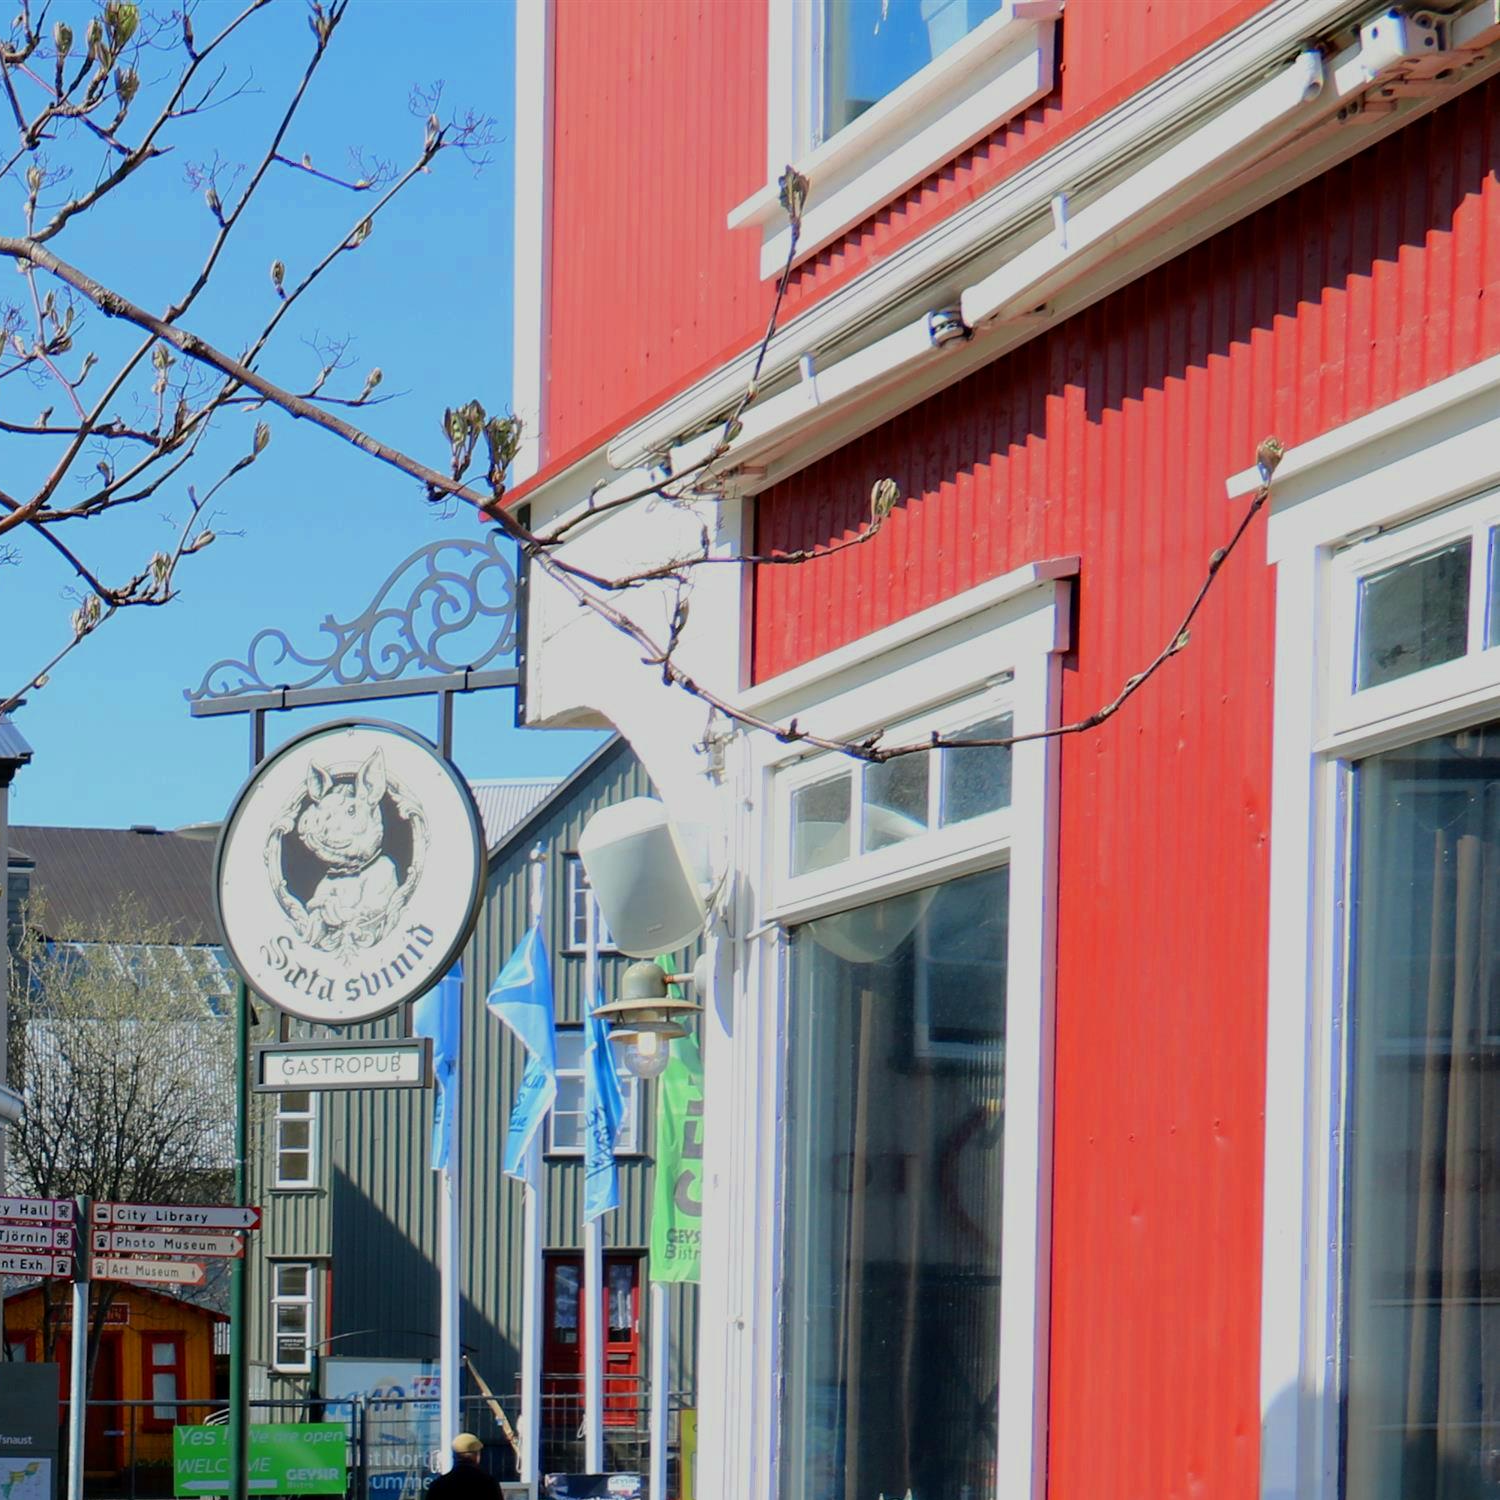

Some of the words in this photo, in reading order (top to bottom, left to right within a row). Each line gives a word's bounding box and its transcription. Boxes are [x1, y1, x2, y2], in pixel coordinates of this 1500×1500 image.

[281, 1056, 401, 1076] GASTROPUB
[19, 1202, 49, 1217] Hall
[116, 1209, 148, 1224] City
[155, 1210, 209, 1224] Library
[116, 1236, 156, 1249] Photo
[164, 1239, 217, 1251] Museum
[667, 1230, 702, 1245] GEYS
[664, 1245, 702, 1260] Bistr
[19, 1257, 48, 1270] Exh.
[111, 1264, 129, 1275] Art
[135, 1265, 180, 1278] Museum
[178, 1427, 216, 1446] Yes
[303, 1430, 344, 1445] open
[177, 1457, 272, 1474] WELCME
[286, 1468, 340, 1480] GEYSIR
